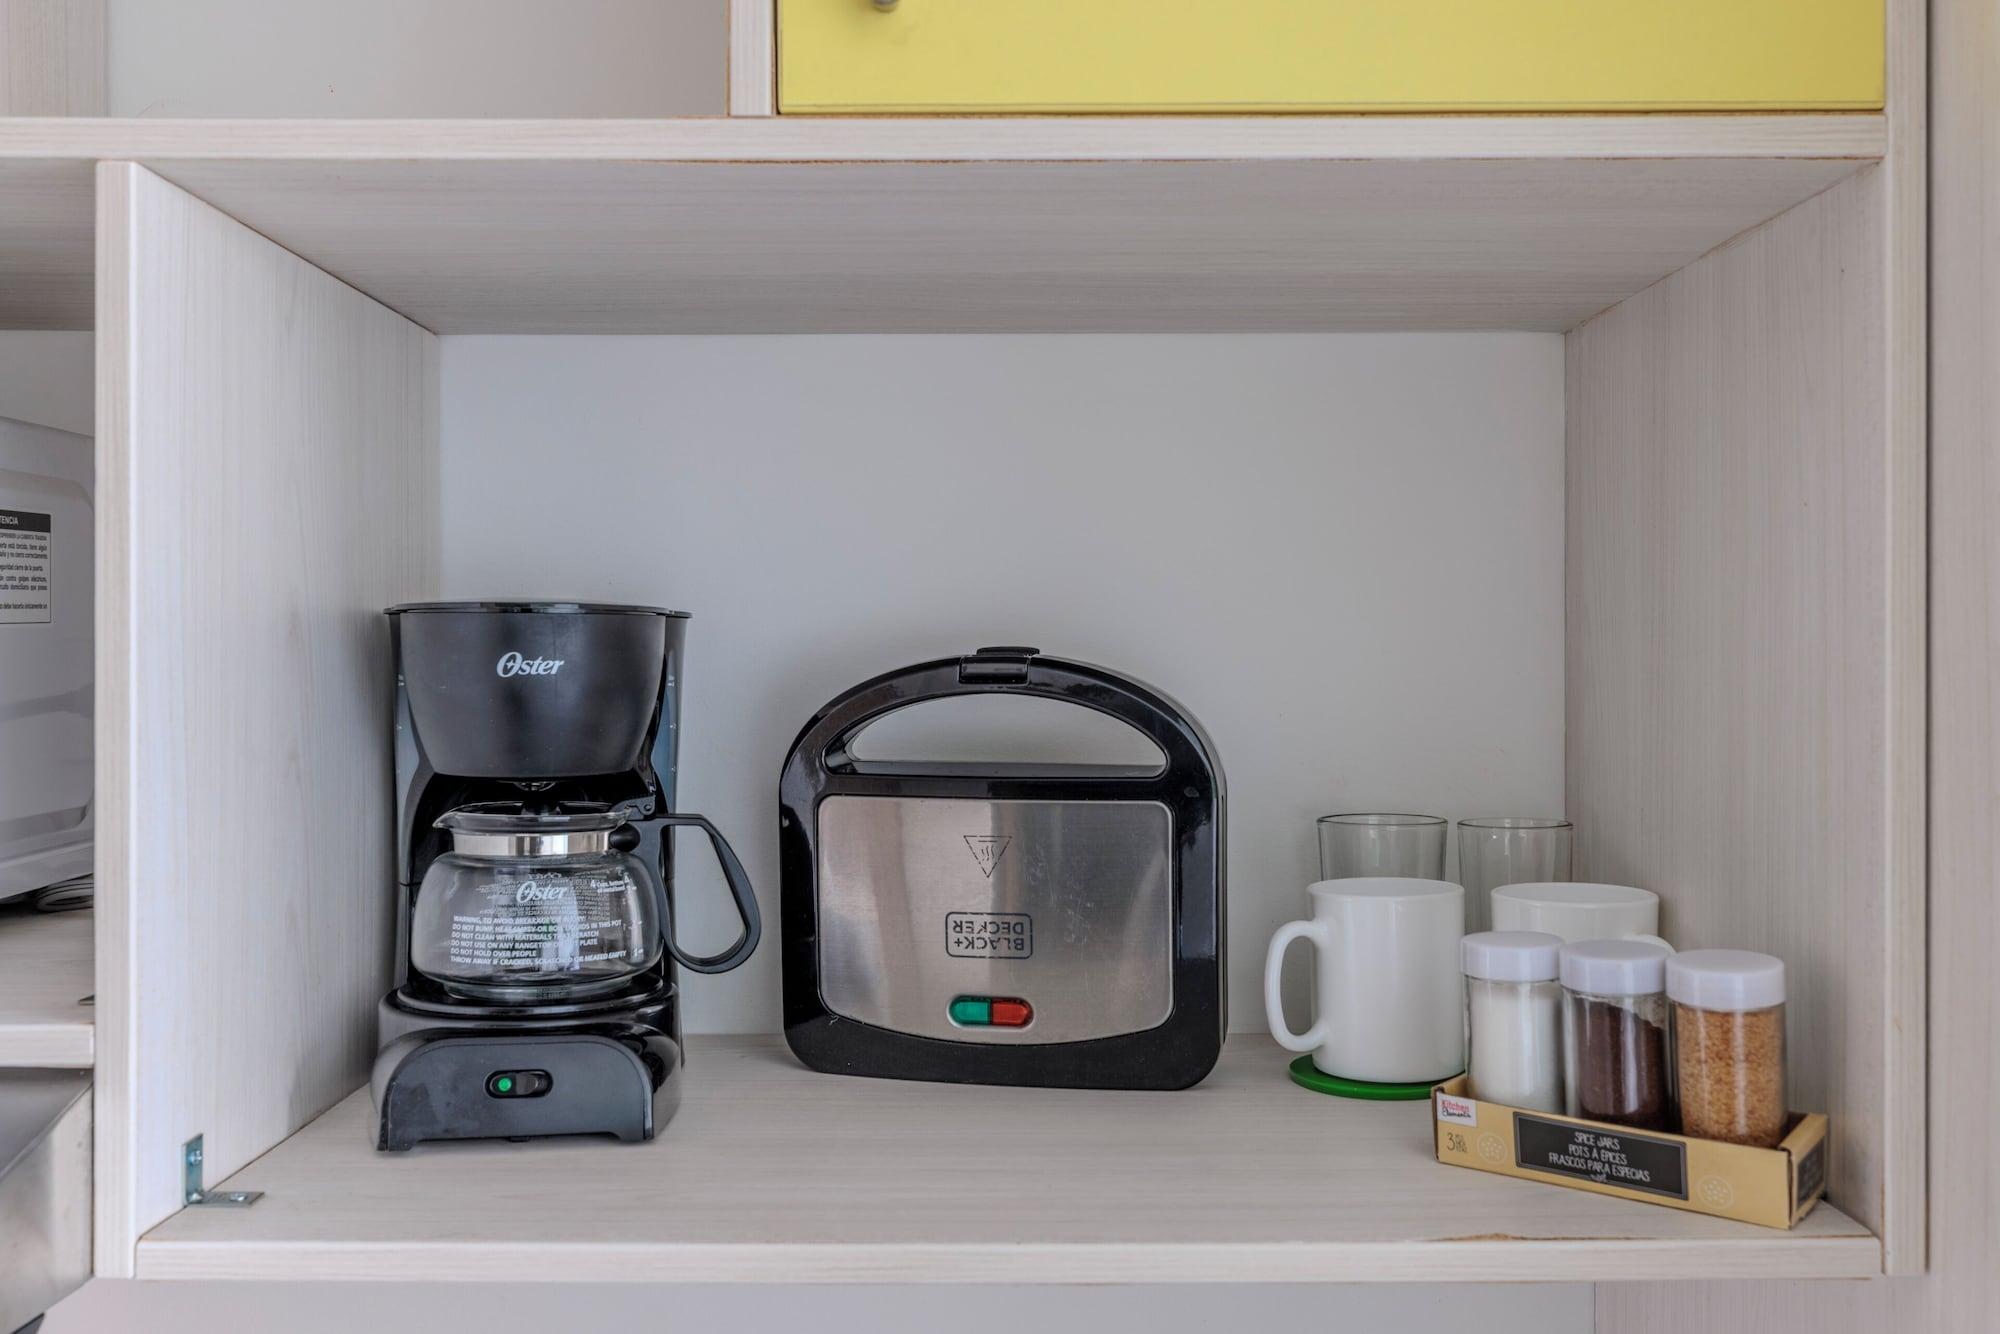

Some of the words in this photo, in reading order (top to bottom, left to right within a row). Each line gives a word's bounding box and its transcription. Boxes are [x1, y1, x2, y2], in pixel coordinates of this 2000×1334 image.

[497, 651, 565, 678] Oster
[516, 881, 567, 903] Oster
[452, 923, 461, 931] DO
[612, 919, 622, 927] POT
[953, 920, 1024, 935] DECKER
[953, 937, 1024, 951] BLACK+
[1447, 1132, 1456, 1151] 3
[1574, 1131, 1596, 1146] SPICE
[1597, 1136, 1621, 1151] JARS
[1568, 1144, 1590, 1159] POTS
[1548, 1152, 1587, 1170] FRASCOS
[1587, 1160, 1612, 1175] PARA
[1612, 1164, 1651, 1183] ESPECIAS
